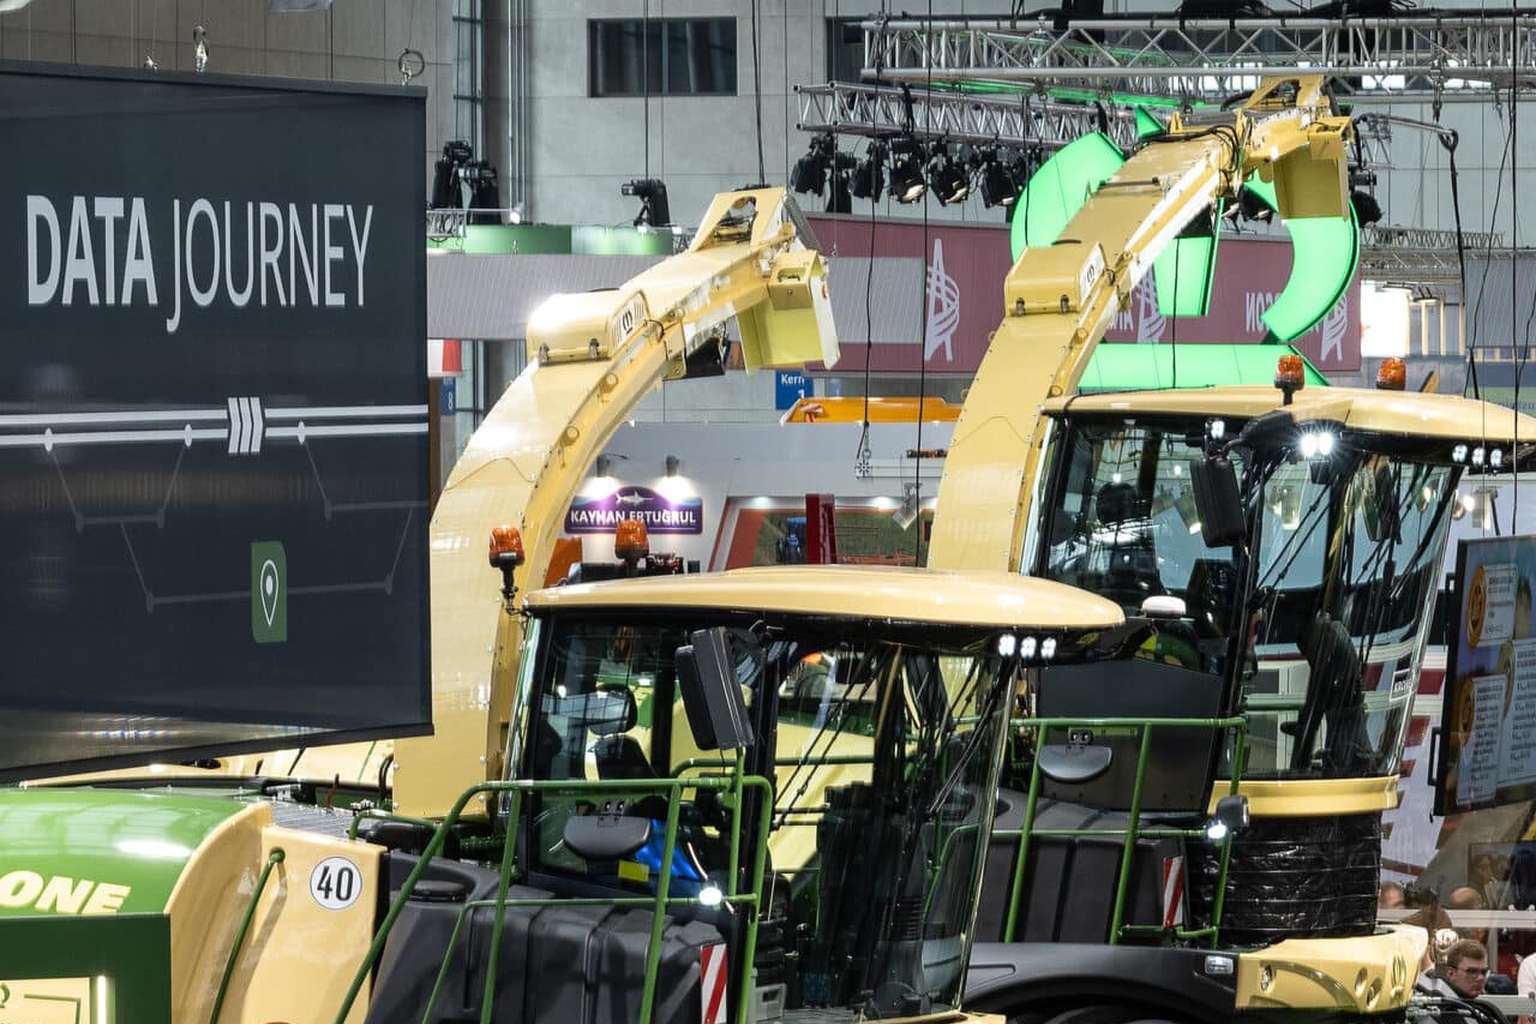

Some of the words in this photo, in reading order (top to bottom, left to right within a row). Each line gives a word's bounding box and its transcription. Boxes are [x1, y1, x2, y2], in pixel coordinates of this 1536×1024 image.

[27, 194, 158, 306] DATA
[166, 198, 374, 333] JOURNEY
[571, 509, 625, 524] KAYHAN
[316, 865, 354, 901] 40
